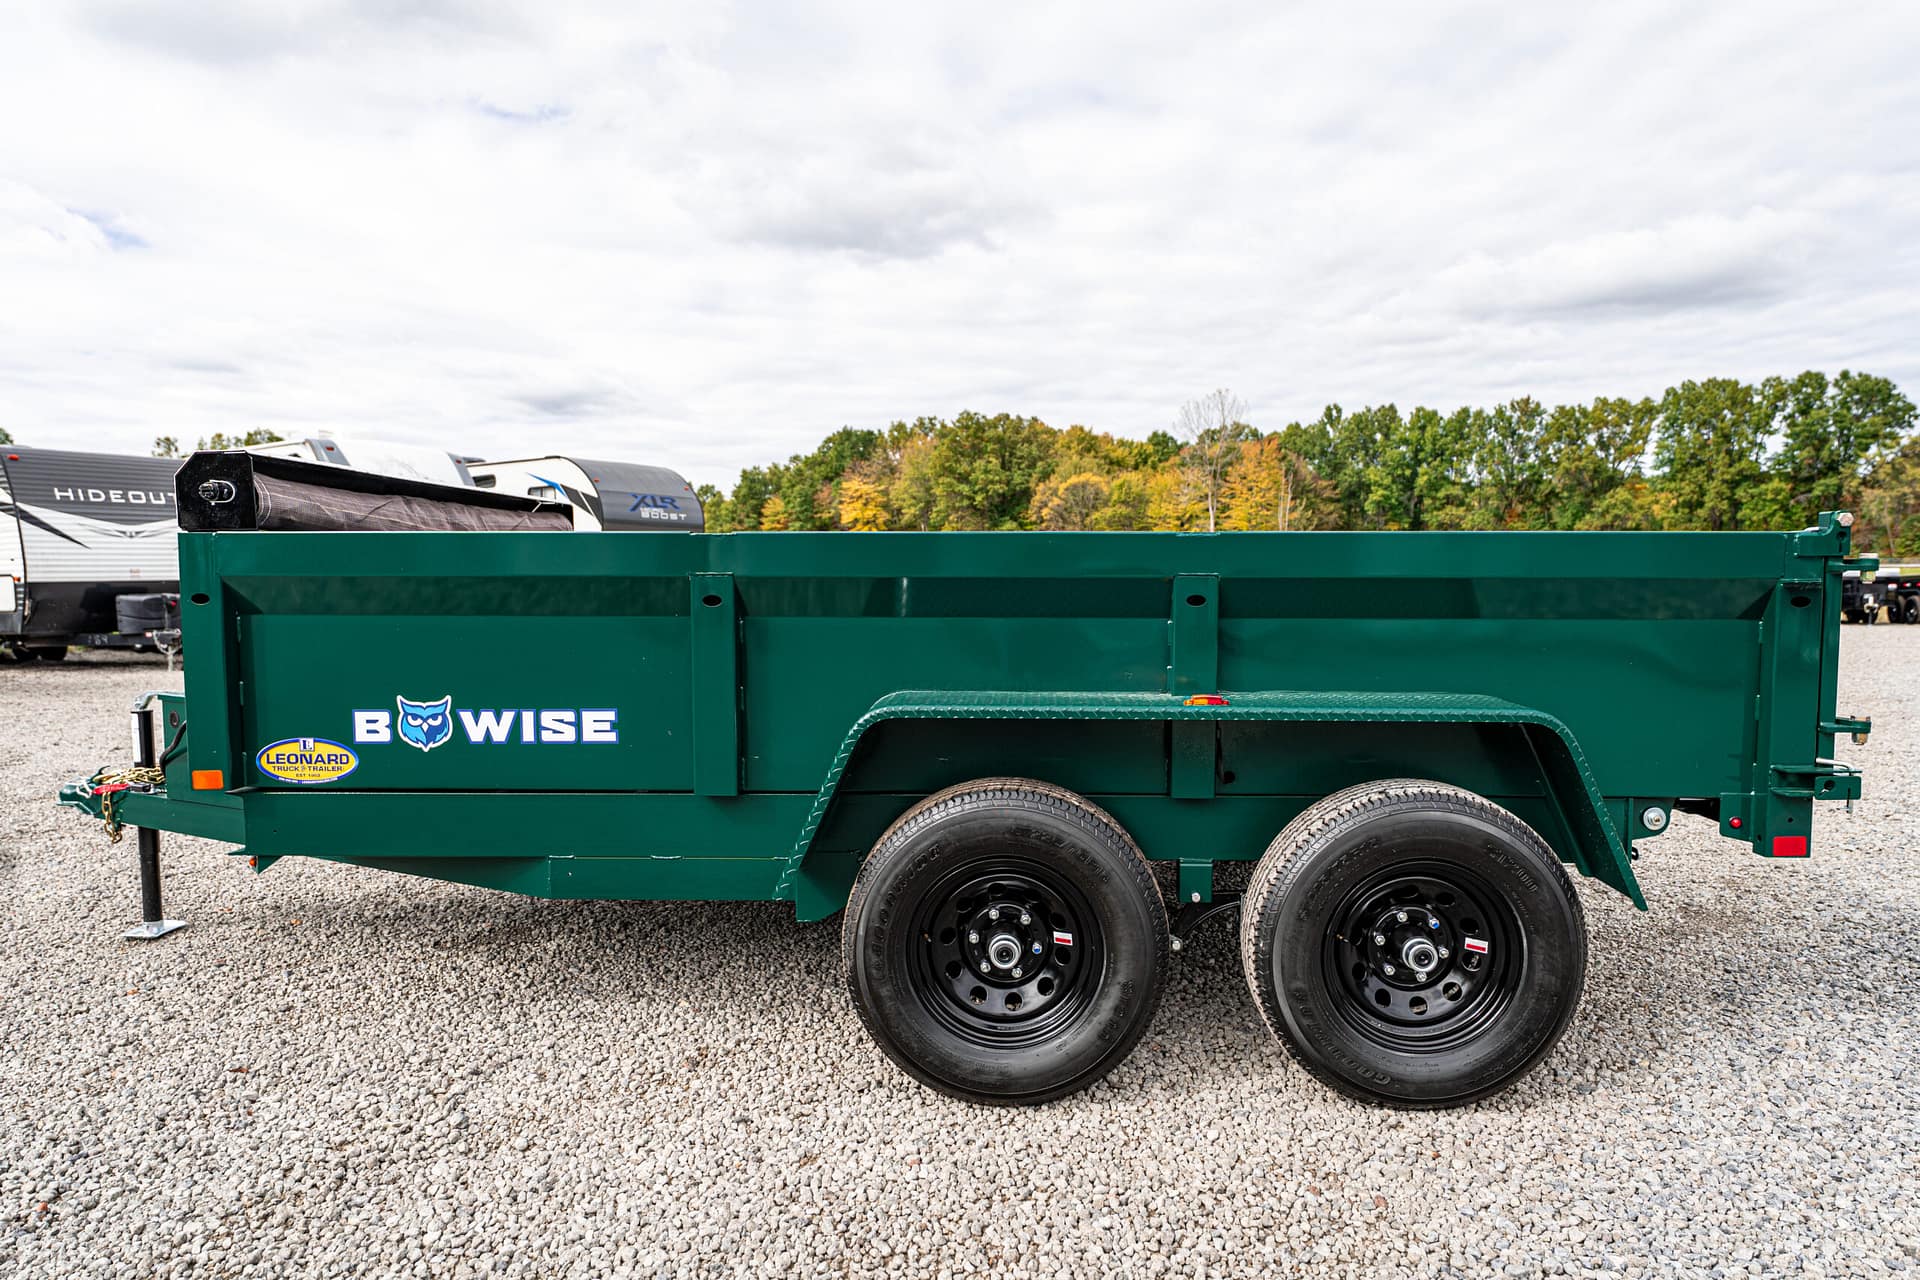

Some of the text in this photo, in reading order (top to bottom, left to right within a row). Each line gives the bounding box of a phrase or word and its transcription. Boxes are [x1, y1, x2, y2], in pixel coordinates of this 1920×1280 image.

[629, 494, 680, 512] XLR
[641, 511, 687, 520] BOOST
[266, 754, 349, 764] LEONARD
